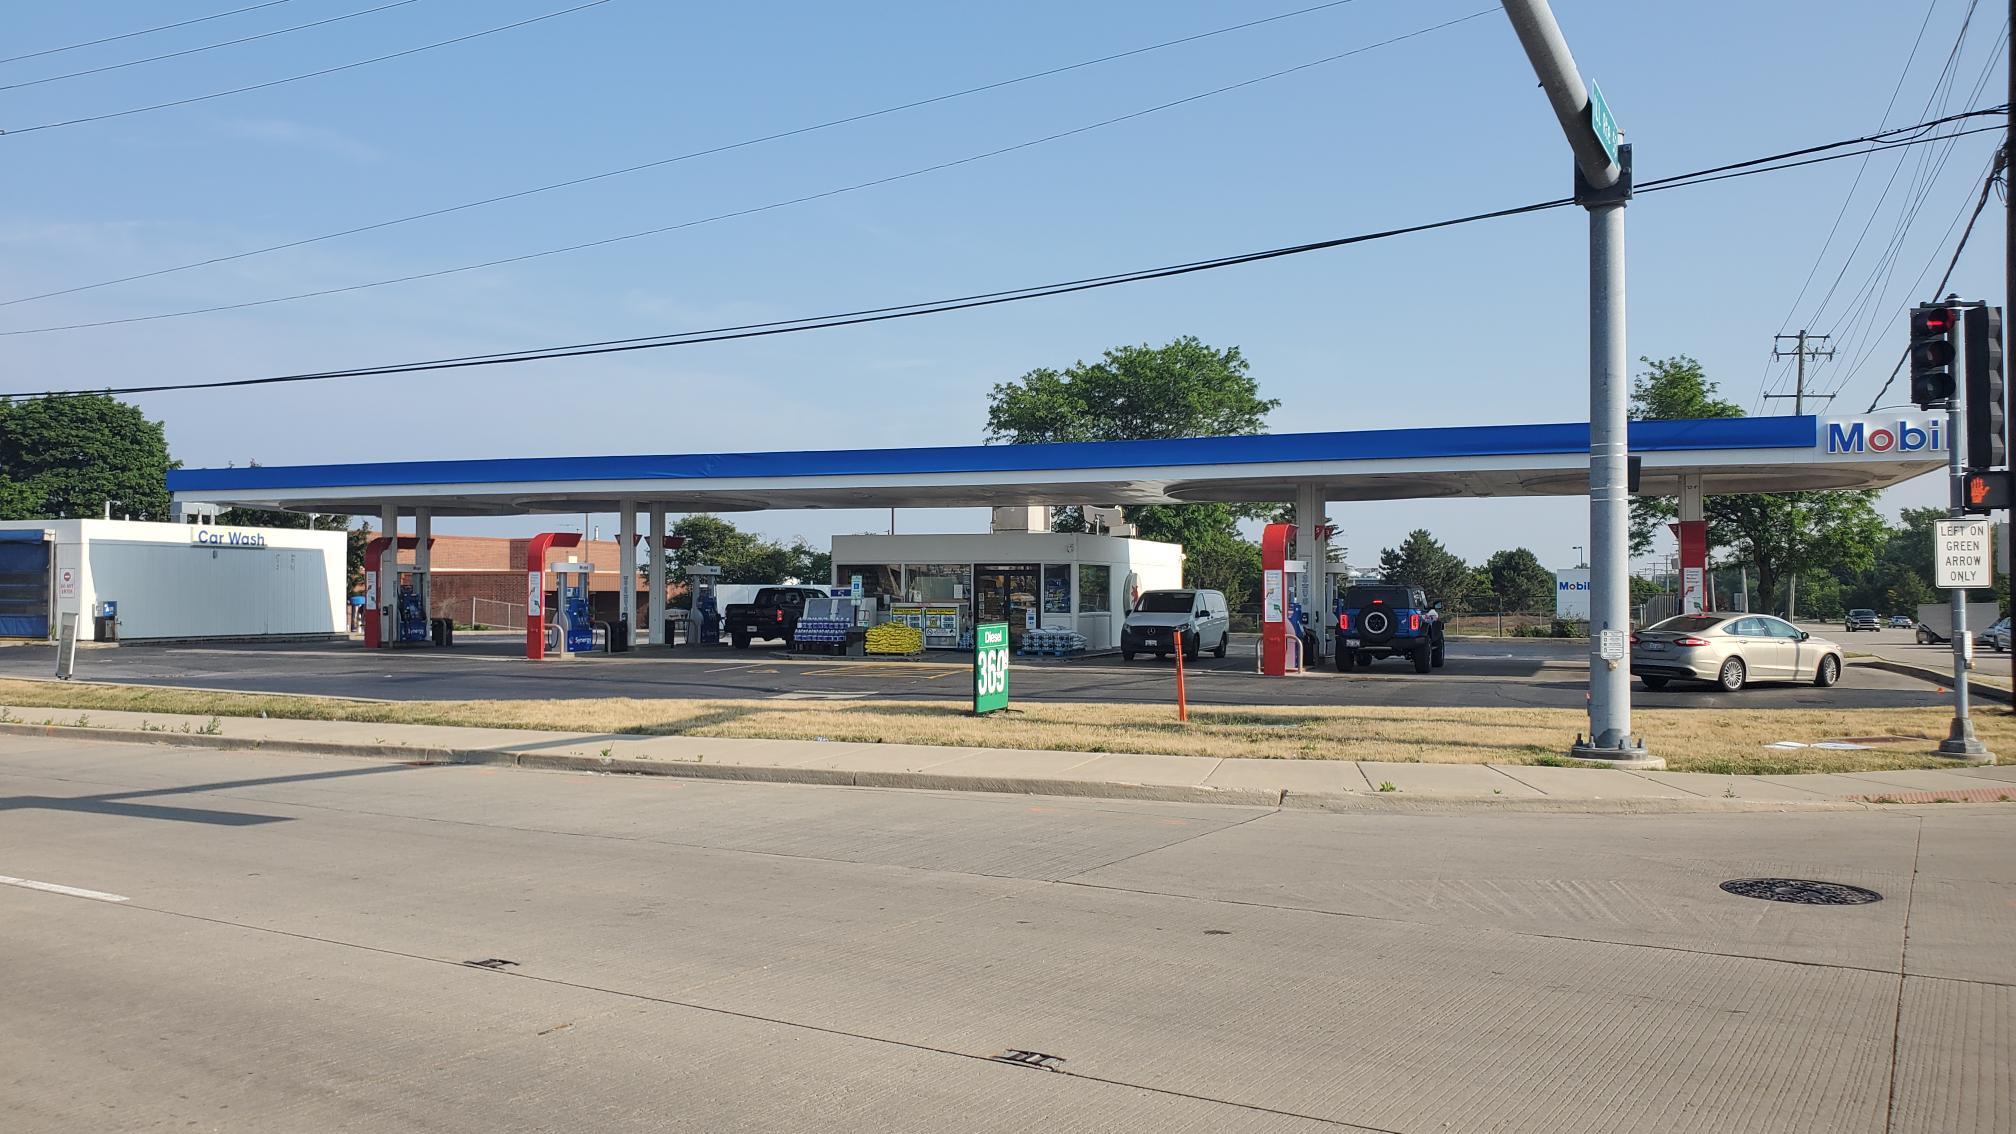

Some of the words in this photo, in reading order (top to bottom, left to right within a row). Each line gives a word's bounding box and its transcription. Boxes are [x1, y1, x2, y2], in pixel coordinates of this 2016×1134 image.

[1940, 526, 1965, 537] LEFT
[1970, 525, 1984, 536] ON
[198, 530, 225, 545] Car
[228, 531, 265, 547] Wash
[1946, 540, 1980, 551] GREEN
[1945, 556, 1981, 567] ARROW
[1950, 570, 1977, 582] ONLY
[1559, 580, 1591, 591] Mobil
[575, 636, 592, 646] Synergy
[984, 630, 1002, 644] Diesel
